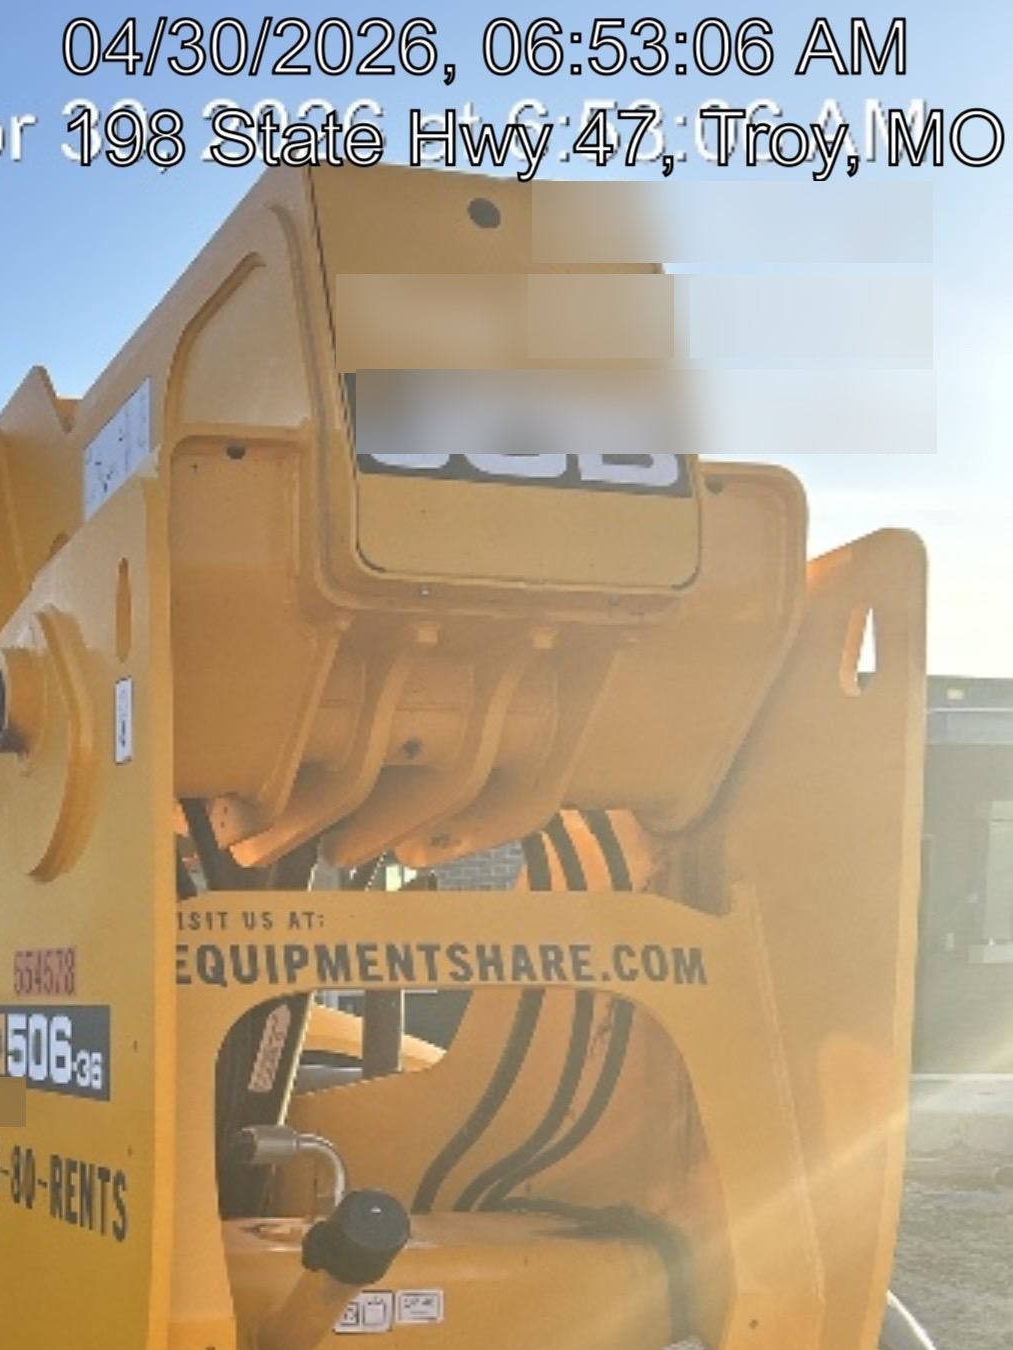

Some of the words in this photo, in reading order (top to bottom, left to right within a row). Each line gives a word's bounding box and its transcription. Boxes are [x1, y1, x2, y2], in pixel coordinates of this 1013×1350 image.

[176, 911, 229, 931] ISIT
[241, 911, 274, 931] US
[176, 943, 708, 988] EQUIPMENTSHARE.COM
